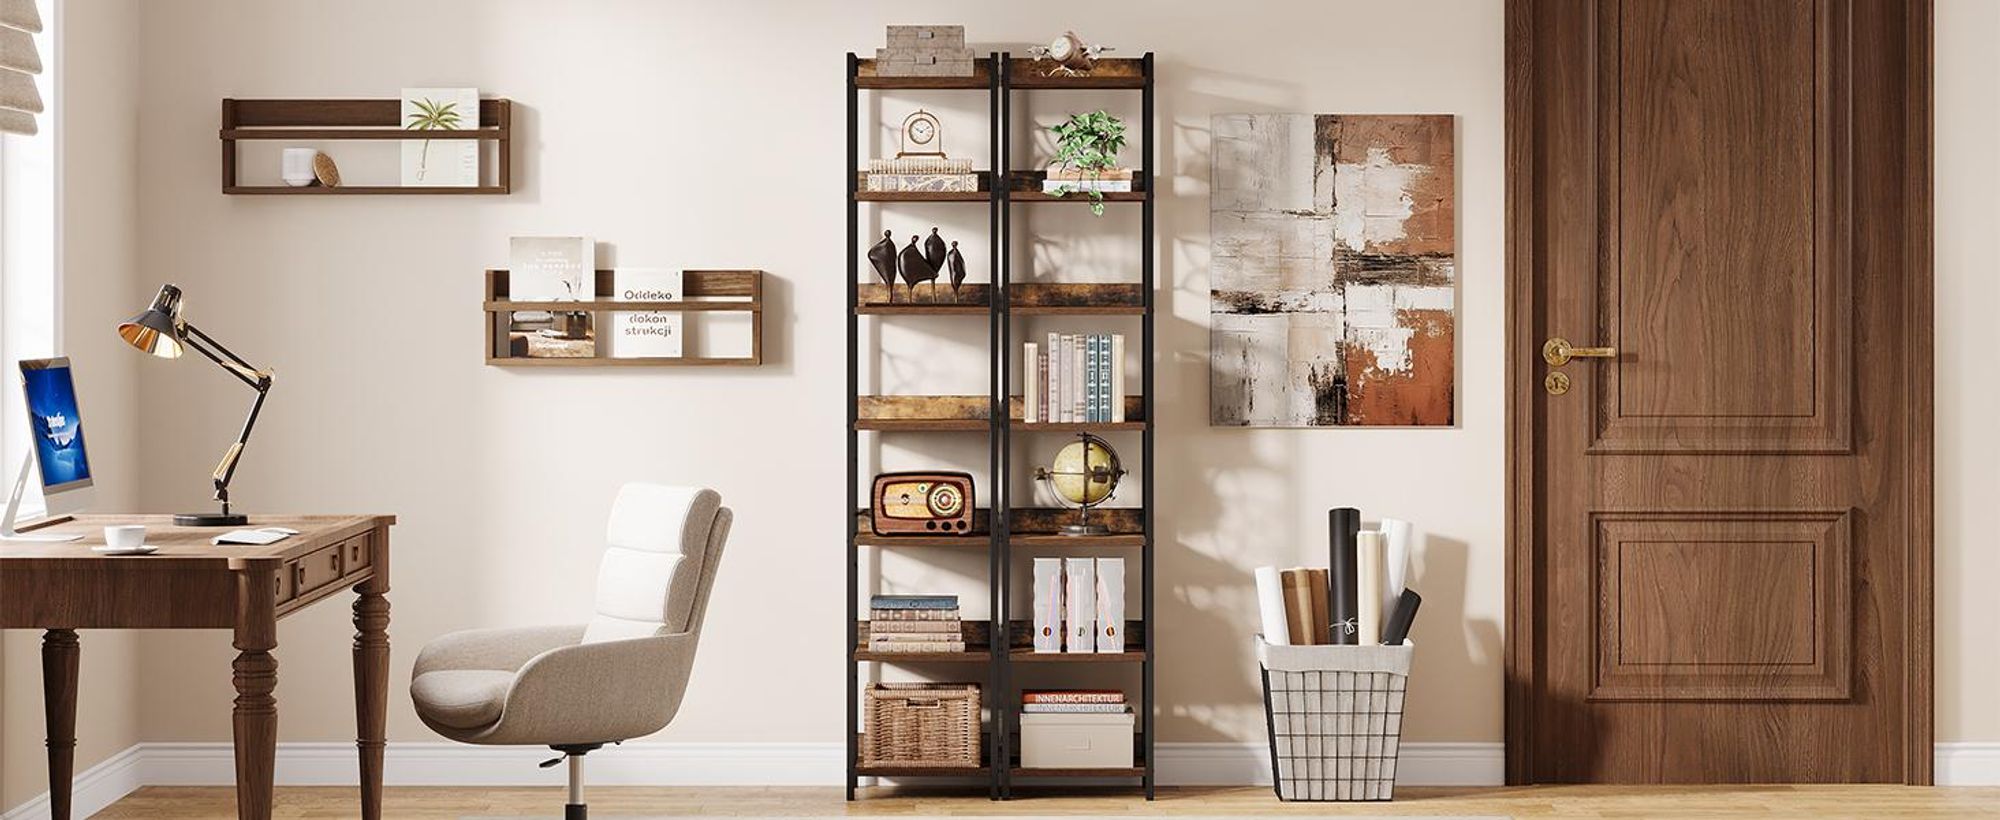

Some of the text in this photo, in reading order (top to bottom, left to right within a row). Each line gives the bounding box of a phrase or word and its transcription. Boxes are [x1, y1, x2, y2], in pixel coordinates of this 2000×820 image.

[624, 289, 672, 300] Oddeko
[629, 313, 667, 324] dokon
[625, 325, 671, 338] strukcji
[1035, 693, 1124, 703] INNENARCHITEKTUR
